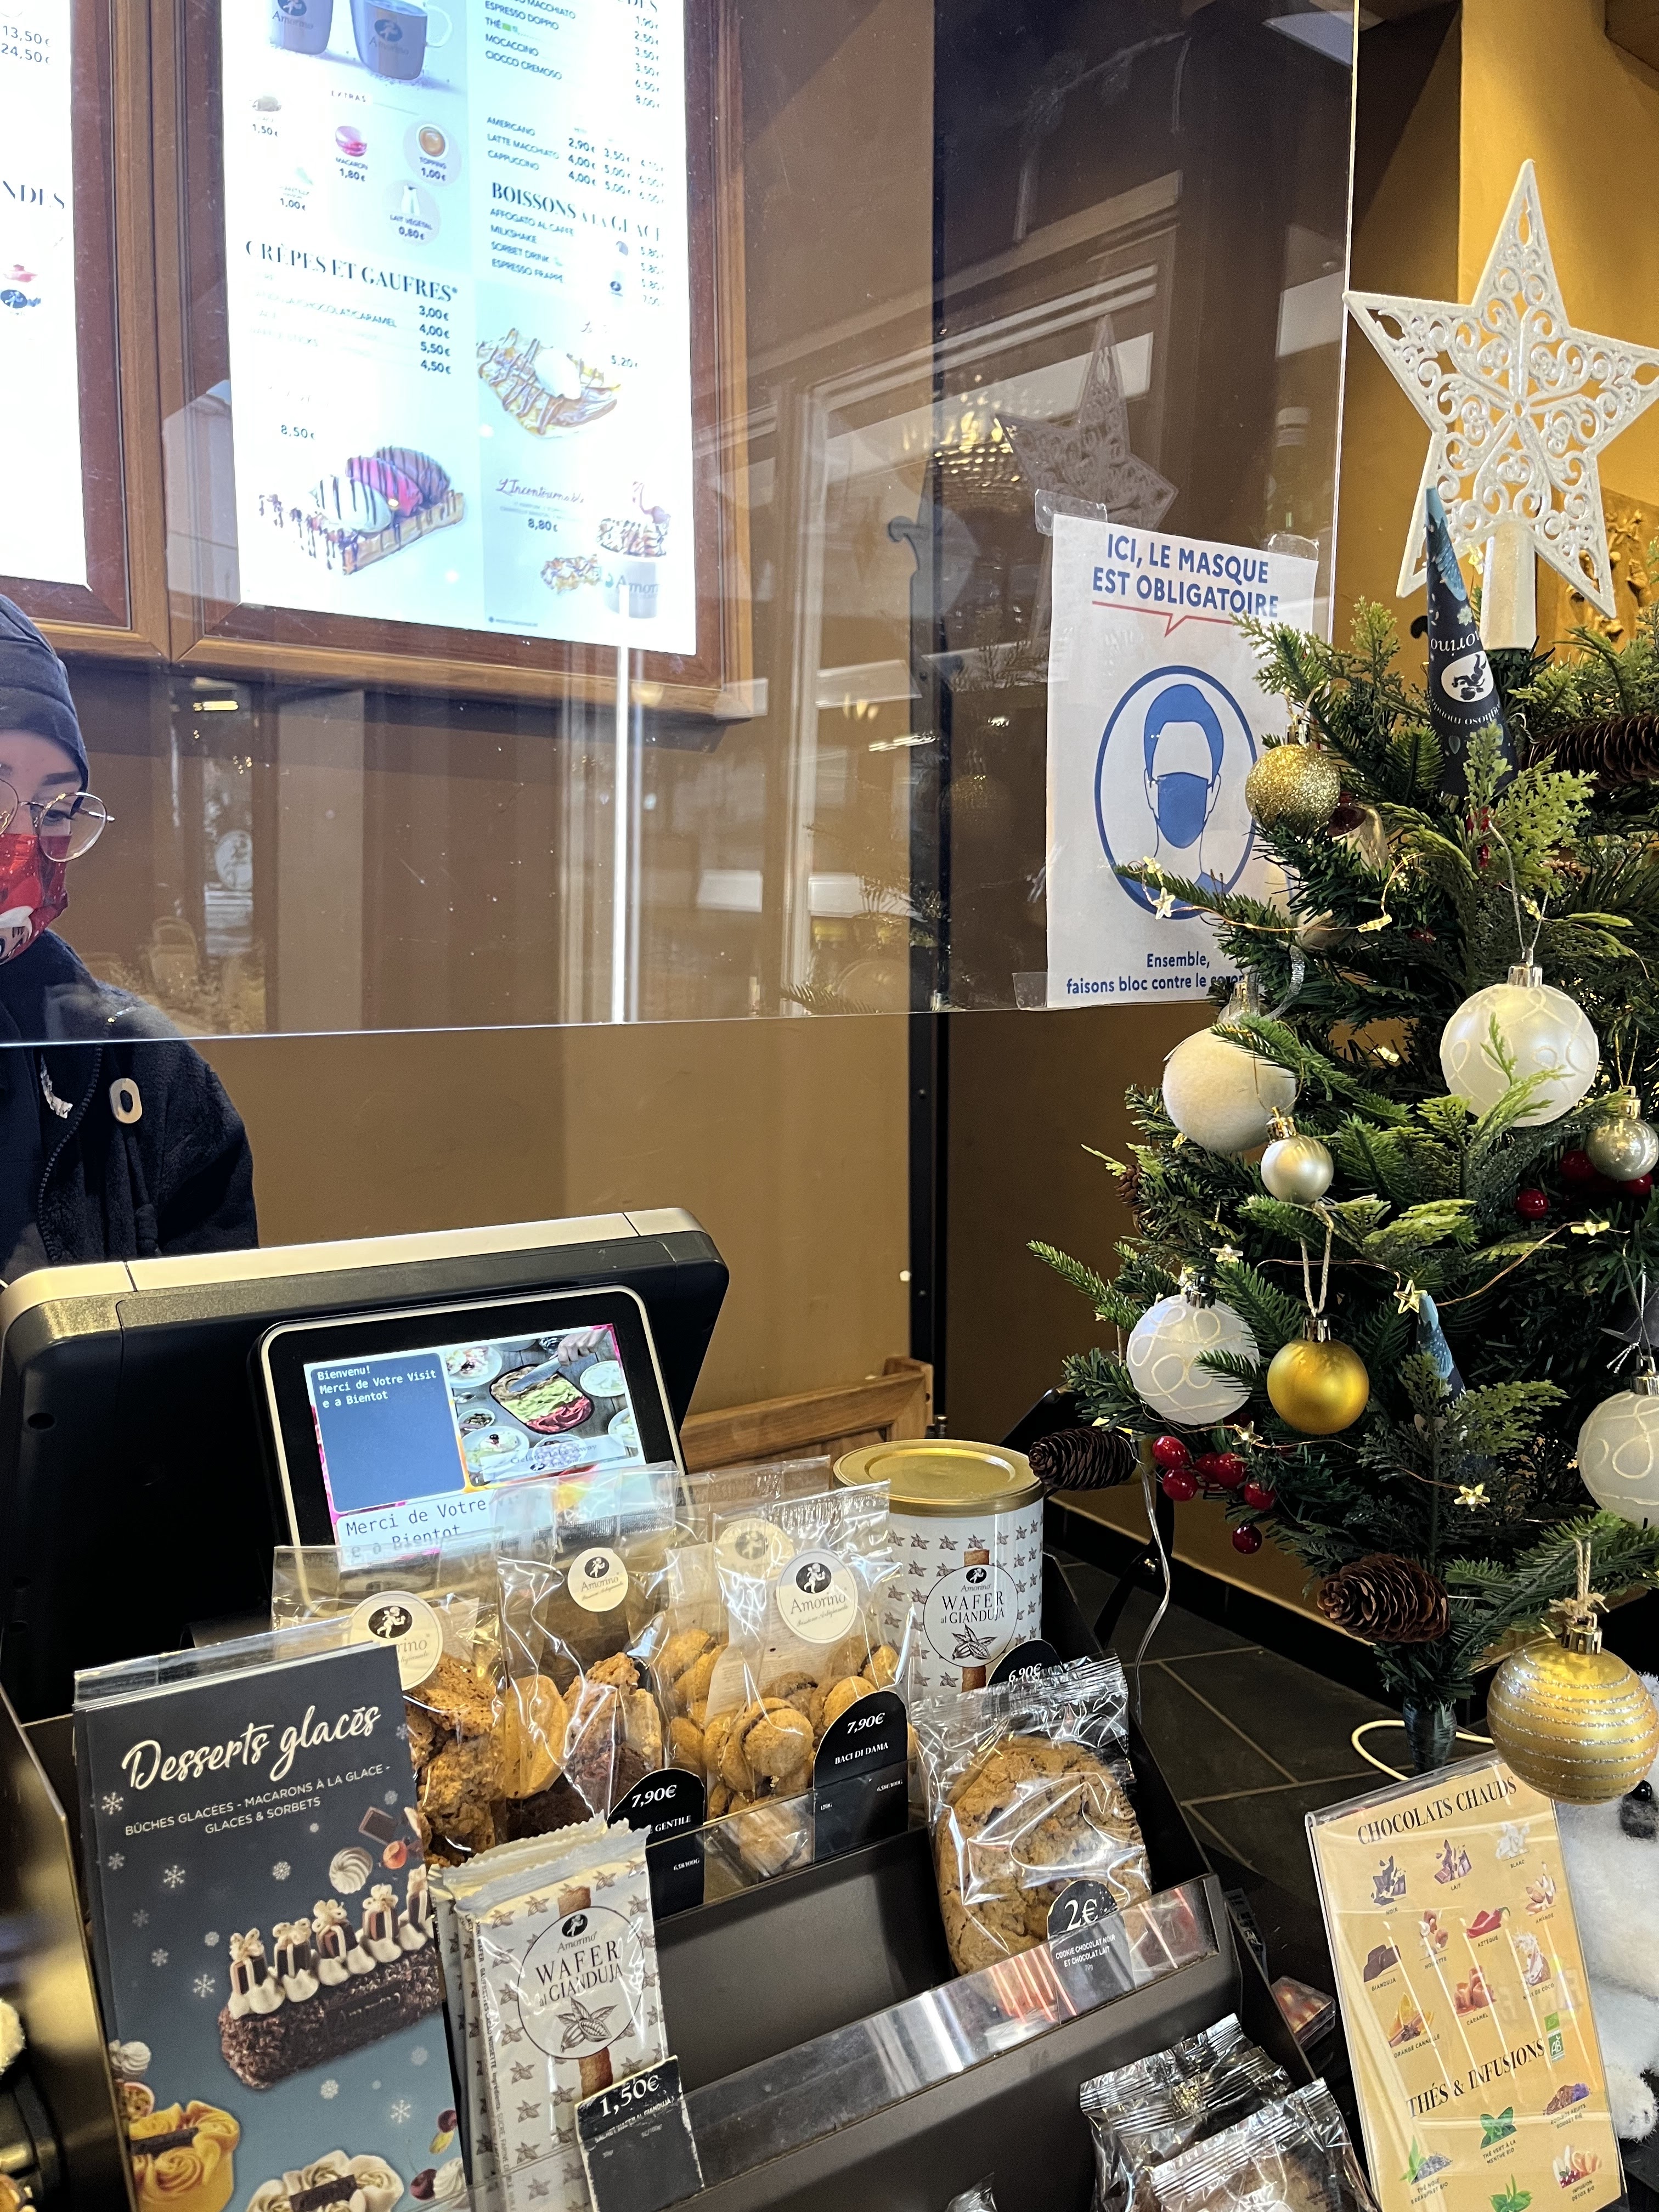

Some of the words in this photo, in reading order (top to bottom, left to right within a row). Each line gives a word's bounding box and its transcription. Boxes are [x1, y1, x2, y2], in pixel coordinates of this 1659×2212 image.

[485, 1, 526, 20] ESPRESSO
[492, 182, 576, 218] BOISSONS
[331, 258, 357, 280] ET
[1107, 534, 1142, 568] ICI,
[1149, 541, 1170, 568] LE
[1179, 547, 1268, 585] MASQUE
[1093, 567, 1130, 595] EST
[1137, 574, 1279, 618] OBLIGATOIRE
[1147, 951, 1210, 968] Ensemble,
[1066, 978, 1114, 994] faisons
[1119, 975, 1147, 991] bloc
[1152, 974, 1191, 989] contre
[1195, 972, 1206, 987] le
[317, 1365, 371, 1381] Bienvenu!
[319, 1379, 351, 1395] Merci
[356, 1377, 370, 1390] de
[373, 1373, 404, 1387] Votre
[408, 1369, 437, 1383] Visit
[323, 1400, 330, 1408] e
[334, 1398, 341, 1407] a
[346, 1390, 388, 1405] Bientot
[346, 1513, 398, 1536] Merci
[409, 1509, 428, 1525] de
[437, 1499, 487, 1518] Votre
[582, 1573, 619, 1592] Amorino
[960, 1583, 991, 1593] Amorino
[791, 1592, 846, 1615] Amorino
[942, 1590, 1004, 1612] WAFER
[949, 1608, 1005, 1624] GIANDUJA
[847, 1712, 886, 1734] 7,90€
[121, 1722, 274, 1791] Desserts
[269, 1705, 381, 1782] glacés
[834, 1752, 853, 1765] BACI
[855, 1750, 864, 1758] DI
[865, 1742, 889, 1756] DAMA
[125, 1815, 175, 1836] BÛCHES
[178, 1800, 234, 1826] GLACÉES
[244, 1782, 313, 1808] MACARONS
[315, 1776, 325, 1791] À
[328, 1774, 343, 1787] LA
[346, 1764, 383, 1783] GLACE
[631, 1785, 677, 1808] 7,90€
[205, 1815, 253, 1835] GLACES
[256, 1812, 263, 1820] &
[267, 1796, 321, 1819] SORBETS
[1357, 1797, 1453, 1845] CHOCOLATS
[1456, 1776, 1517, 1812] CHAUDS
[655, 1815, 691, 1832] GENTILE
[1510, 1859, 1525, 1869] BLANC
[1064, 1898, 1099, 1932] 2€
[557, 1931, 596, 1954] Amorino
[1056, 1947, 1075, 1960] COOKIE
[1075, 1938, 1102, 1953] CHOCOLAT
[1103, 1934, 1116, 1943] NOIR
[535, 1940, 620, 1987] WAFER
[1064, 1959, 1071, 1967] ET
[1071, 1949, 1098, 1965] CHOCOLAT
[1099, 1946, 1110, 1956] LAIT
[539, 1996, 547, 2008] al
[549, 1962, 623, 2002] GIANDUJA
[1372, 1978, 1396, 1991] GIANDUJA
[1466, 2013, 1488, 2025] CARAMEL
[1406, 2083, 1449, 2119] THÉS
[1453, 2080, 1465, 2097] &
[1468, 2038, 1545, 2091] INFUSIONS
[600, 2074, 660, 2118] 1,50€
